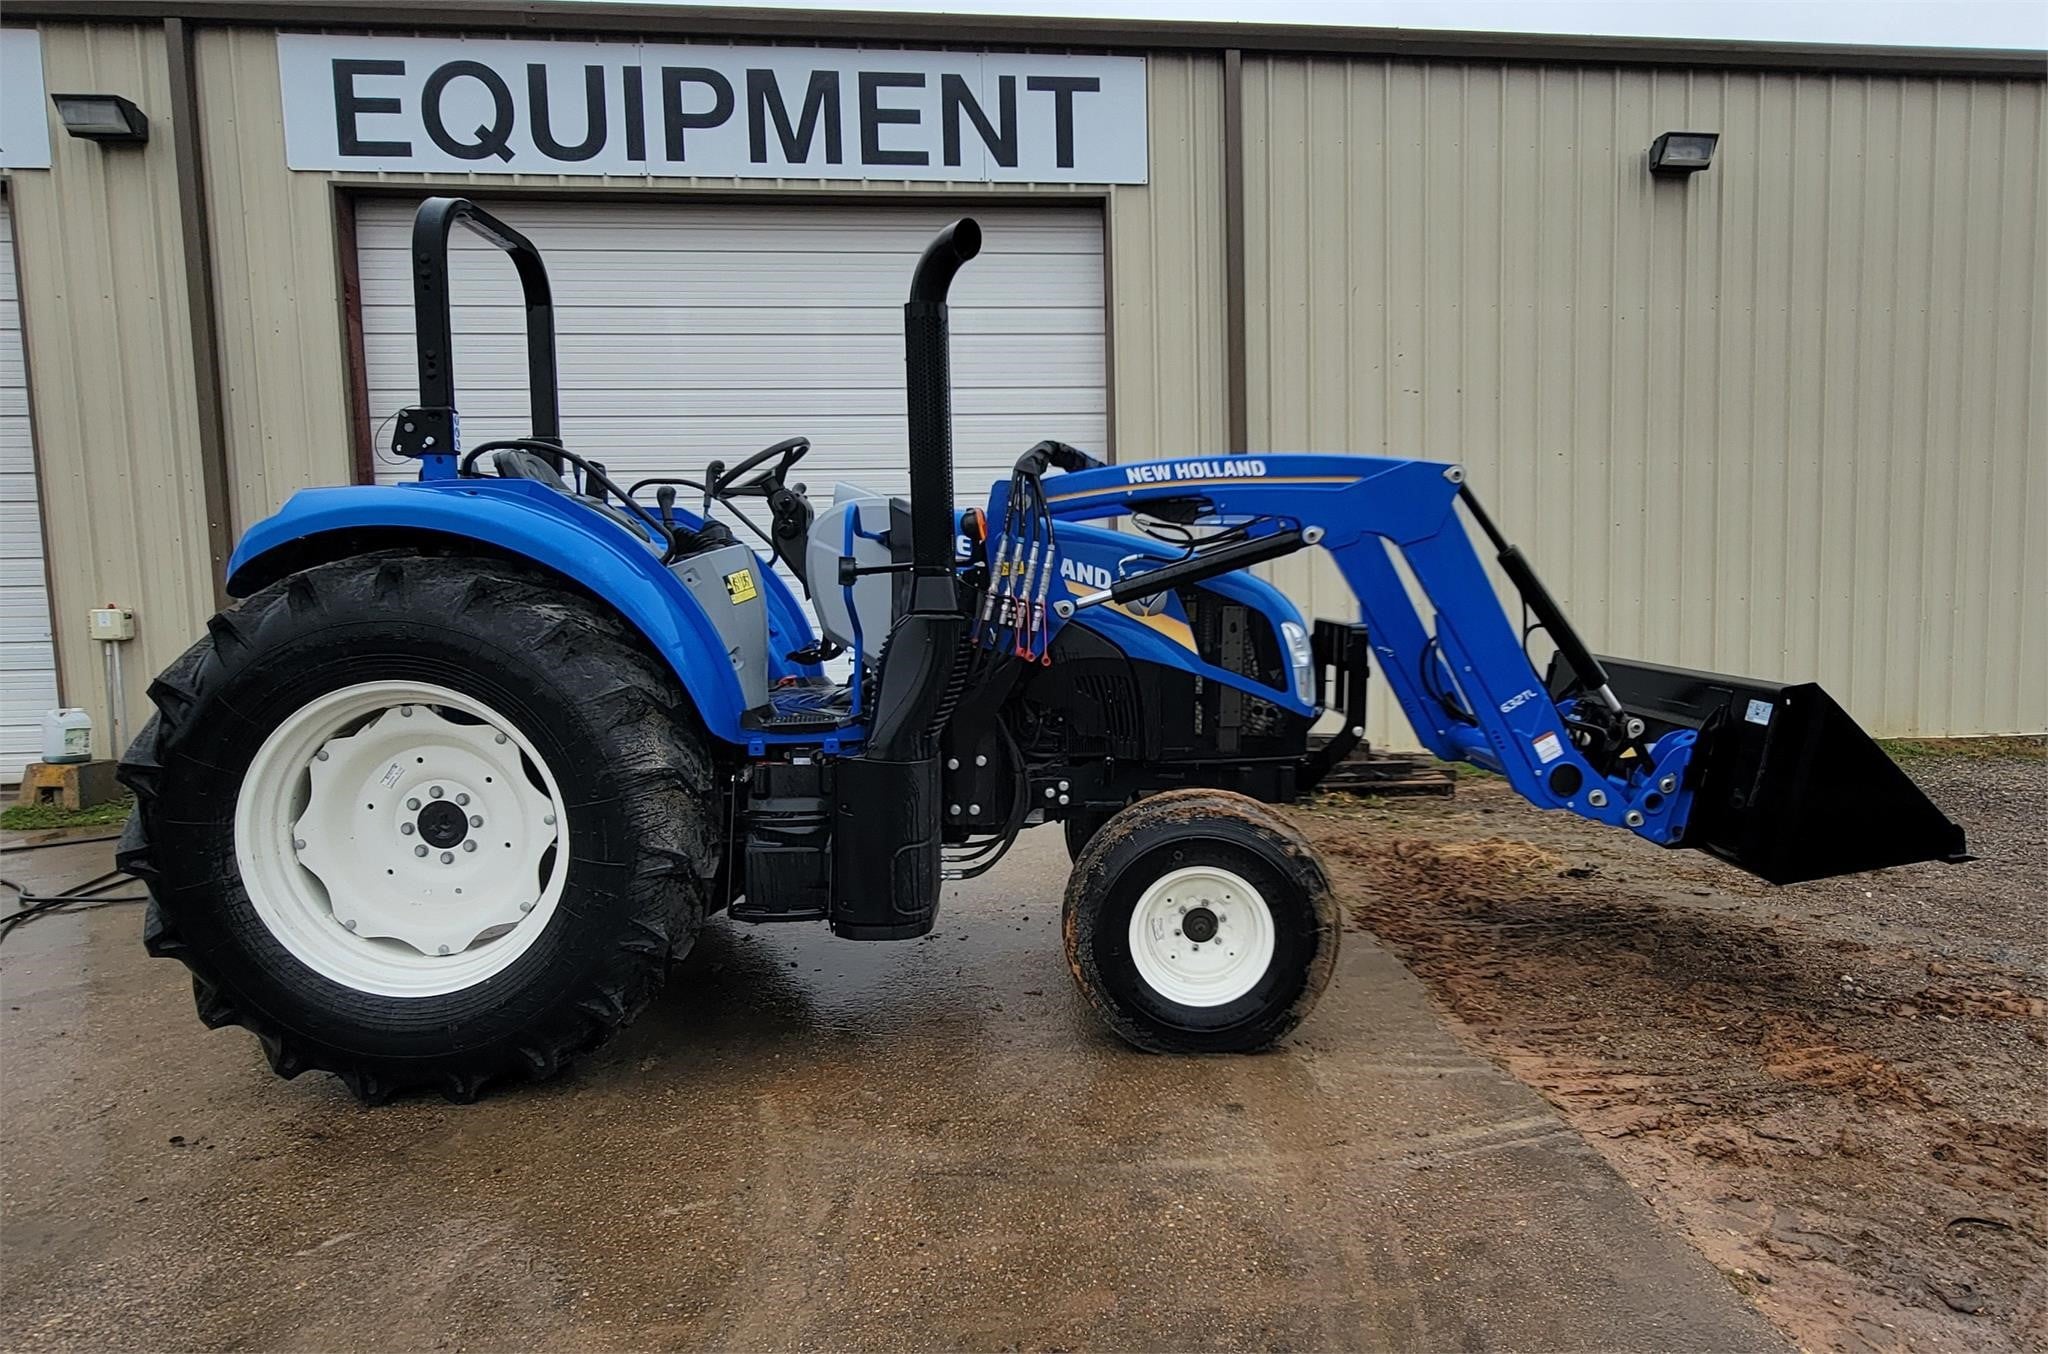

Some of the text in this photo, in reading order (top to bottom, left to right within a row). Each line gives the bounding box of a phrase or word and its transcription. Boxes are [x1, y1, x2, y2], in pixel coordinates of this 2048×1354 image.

[331, 58, 1101, 169] EQUIPMENT
[1125, 460, 1267, 484] NEW HOLLAND
[1500, 689, 1538, 713] 632TL
